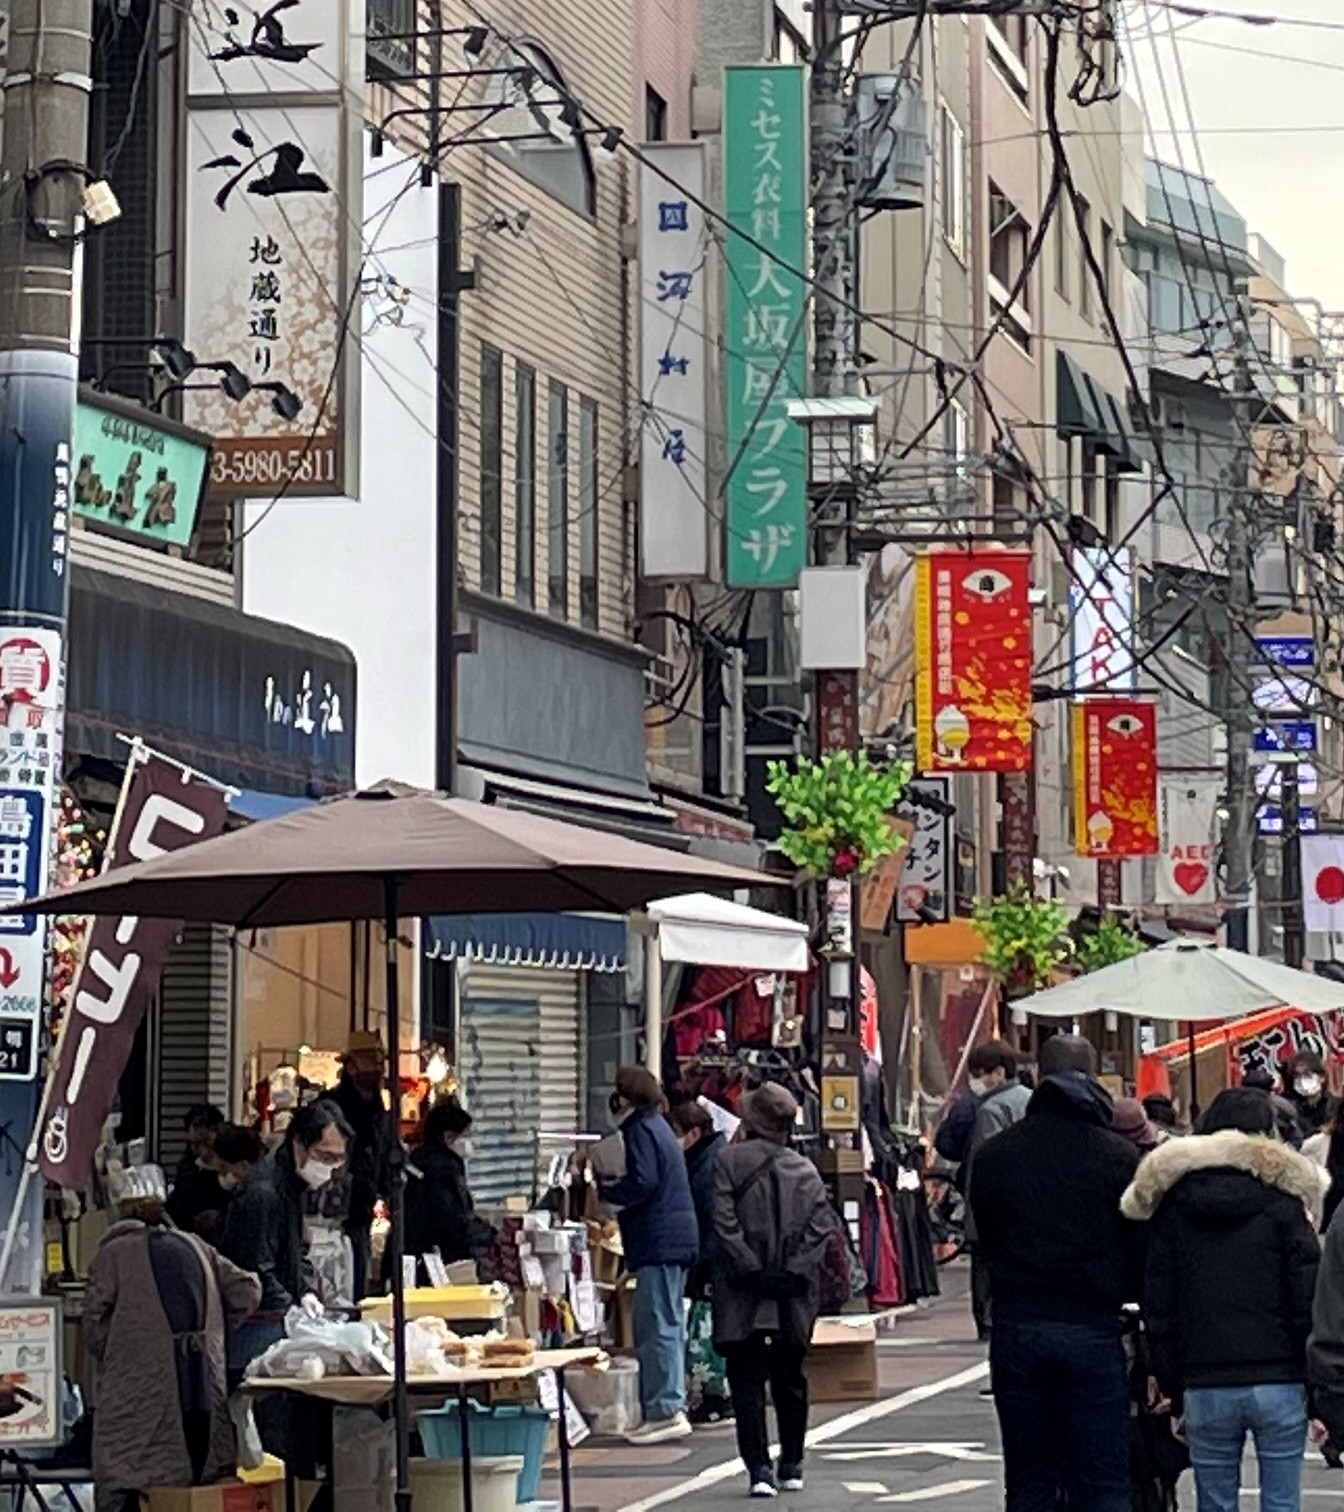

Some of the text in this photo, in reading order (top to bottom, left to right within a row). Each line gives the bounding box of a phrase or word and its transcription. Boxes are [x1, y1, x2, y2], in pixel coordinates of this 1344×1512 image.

[749, 76, 784, 241] ミセス衣料
[248, 235, 283, 377] 地蔵通り
